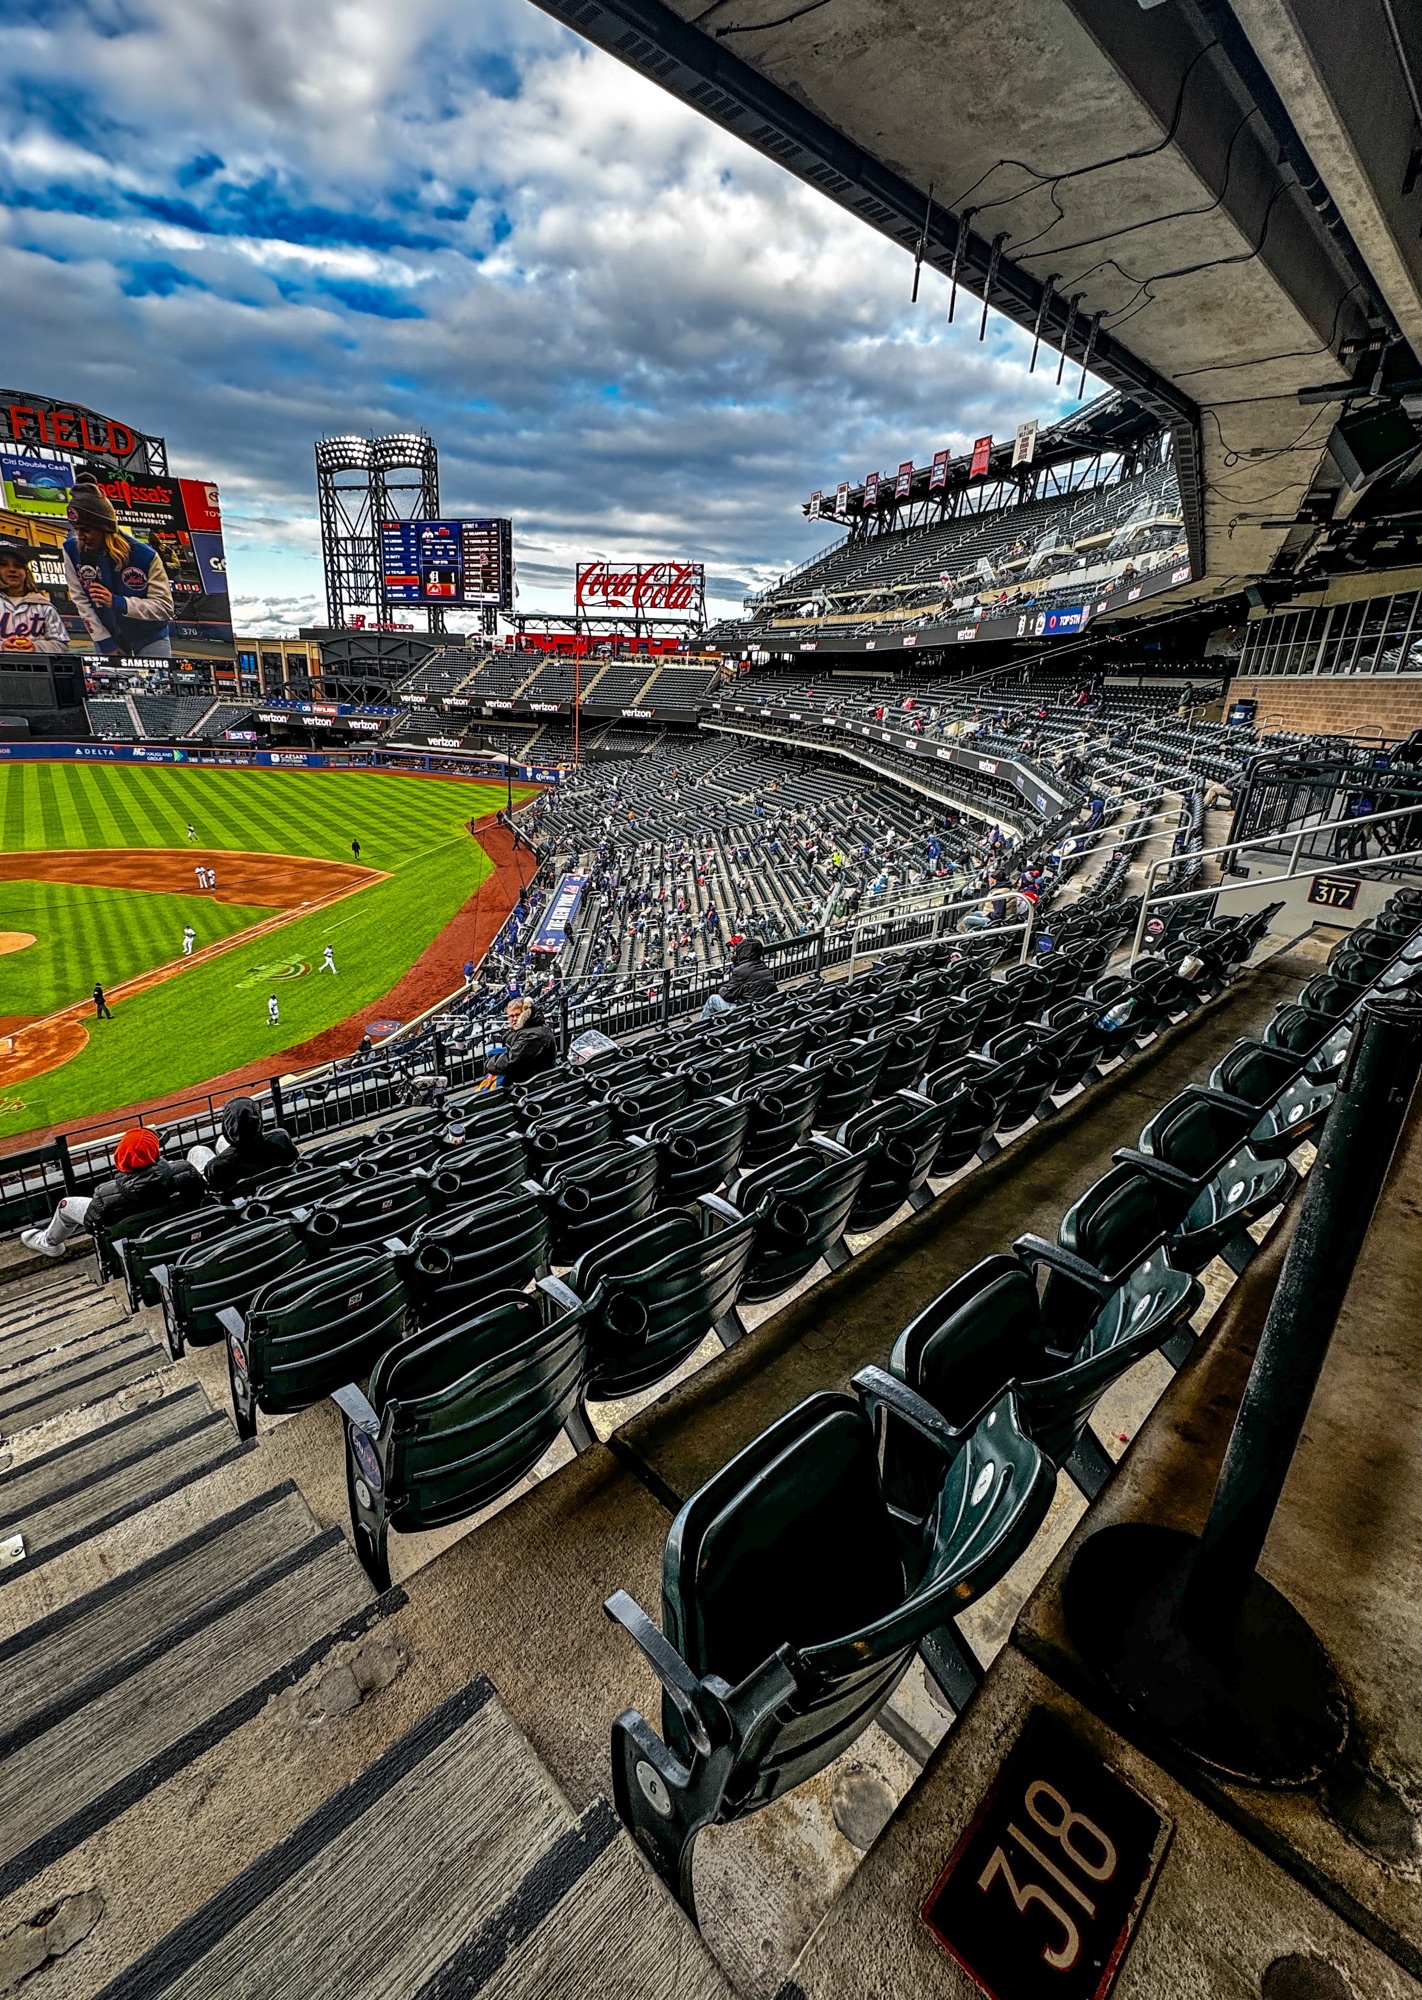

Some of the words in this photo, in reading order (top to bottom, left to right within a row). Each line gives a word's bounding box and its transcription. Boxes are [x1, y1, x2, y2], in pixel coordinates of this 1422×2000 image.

[9, 405, 135, 455] FIELD
[2, 458, 17, 466] Citi
[18, 460, 47, 469] Double
[48, 463, 69, 471] Cash
[576, 562, 693, 609] Coca-Cola
[1059, 616, 1069, 626] TOP
[182, 627, 198, 636] 370
[120, 658, 169, 668] SAMSUNG
[400, 694, 426, 703] verizon
[441, 696, 469, 706] verizon
[484, 699, 512, 709] verizon
[529, 702, 559, 712] verizon
[258, 713, 288, 723] verizon
[621, 708, 652, 718] verizon
[302, 716, 332, 726] verizon
[348, 719, 379, 730] verizon
[427, 736, 460, 748] verizon
[85, 748, 115, 756] DELTA
[1315, 885, 1350, 906] 317
[650, 1780, 657, 1795] 6
[977, 1780, 1117, 1972] 318
